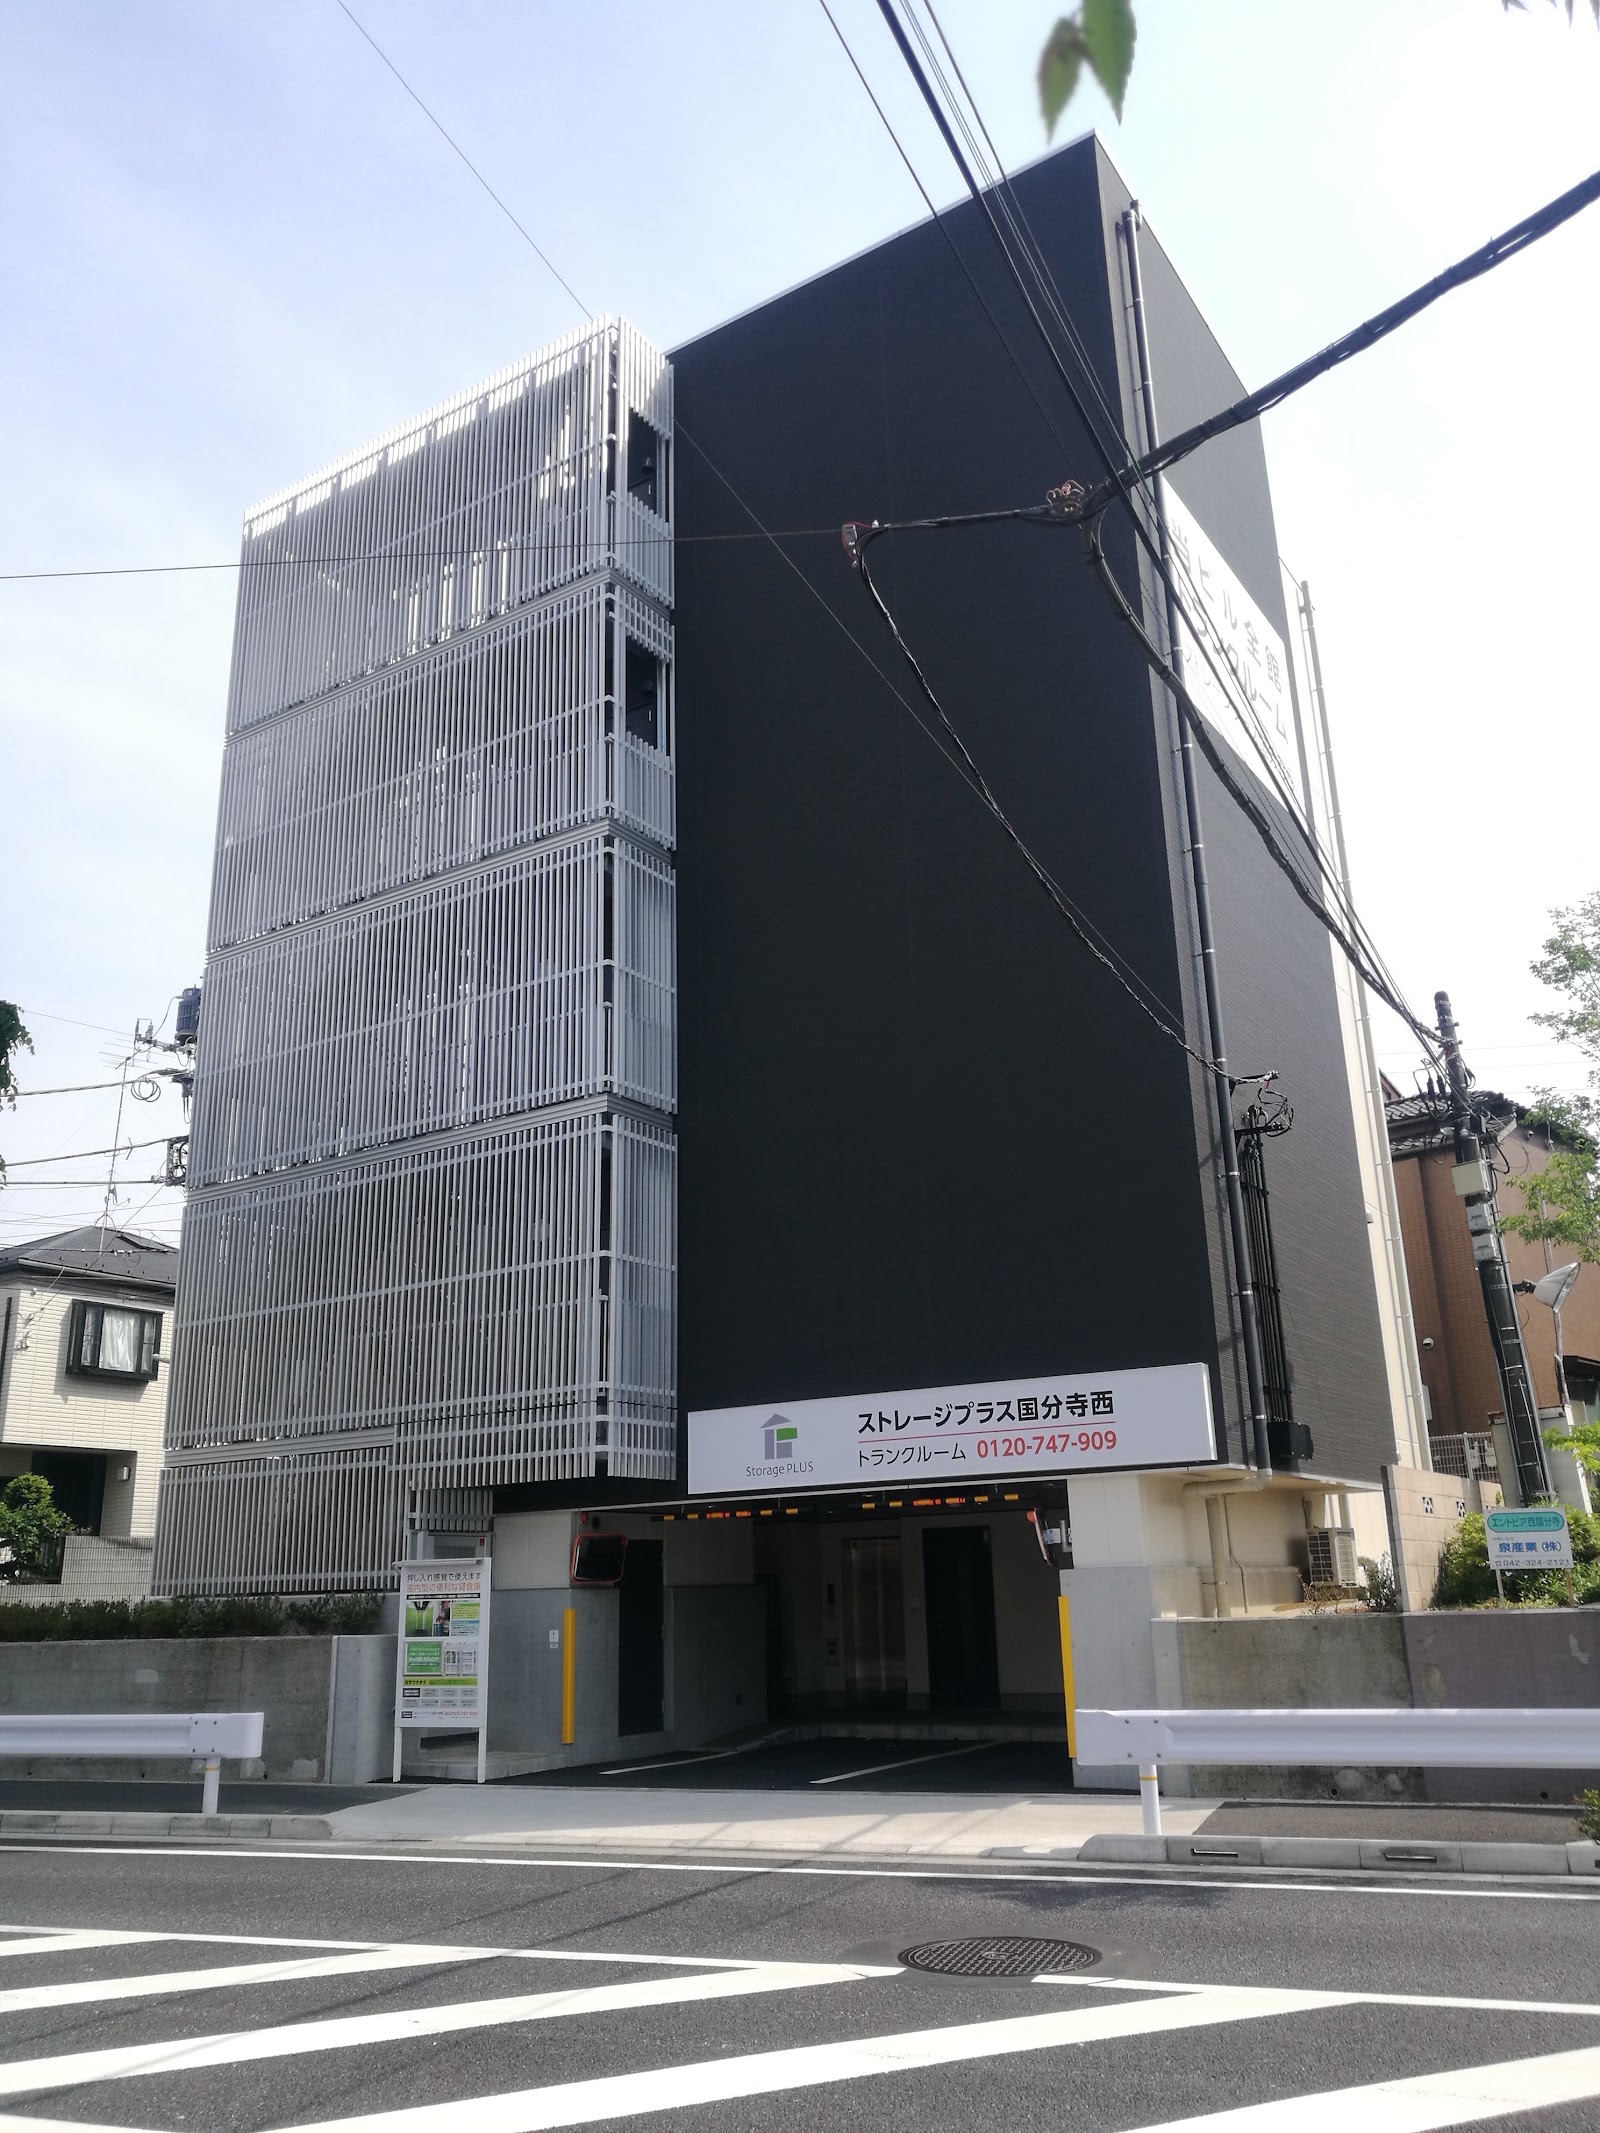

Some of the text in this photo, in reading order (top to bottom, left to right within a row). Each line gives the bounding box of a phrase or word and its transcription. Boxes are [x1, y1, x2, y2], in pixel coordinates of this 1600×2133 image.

[1170, 516, 1283, 695] 当ビル全館
[857, 1390, 1115, 1434] ストレージプラス国分寺西
[857, 1430, 1117, 1468] トランクルーム 0120-747-909
[746, 1461, 814, 1478] Storage PLUS
[406, 1572, 481, 1583] 押し入れ感覚で使えます
[406, 1581, 481, 1593] 室内型の便利な貸倉庫
